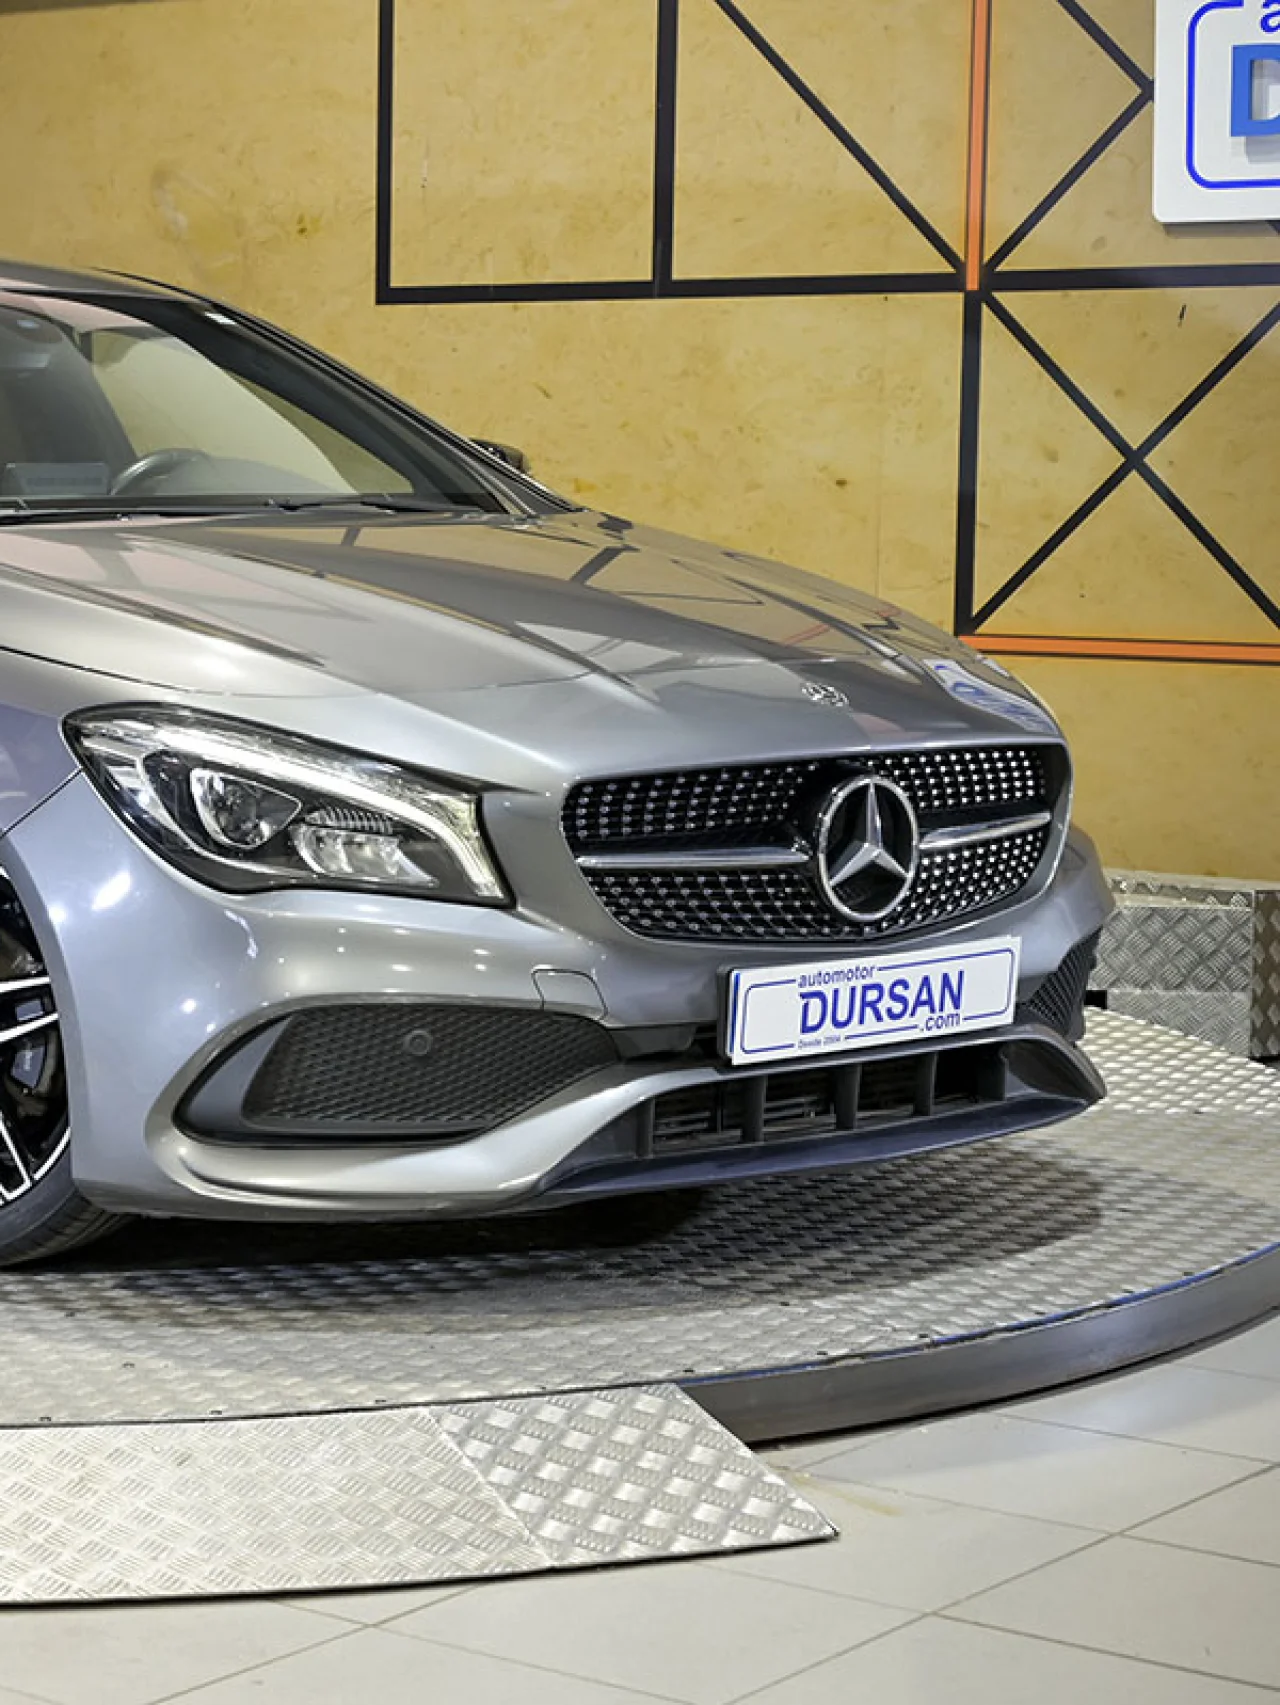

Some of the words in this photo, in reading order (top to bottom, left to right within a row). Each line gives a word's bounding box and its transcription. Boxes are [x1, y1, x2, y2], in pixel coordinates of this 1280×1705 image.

[798, 965, 876, 988] automotor
[799, 970, 965, 1034] DURSAN
[919, 1013, 961, 1032] .com
